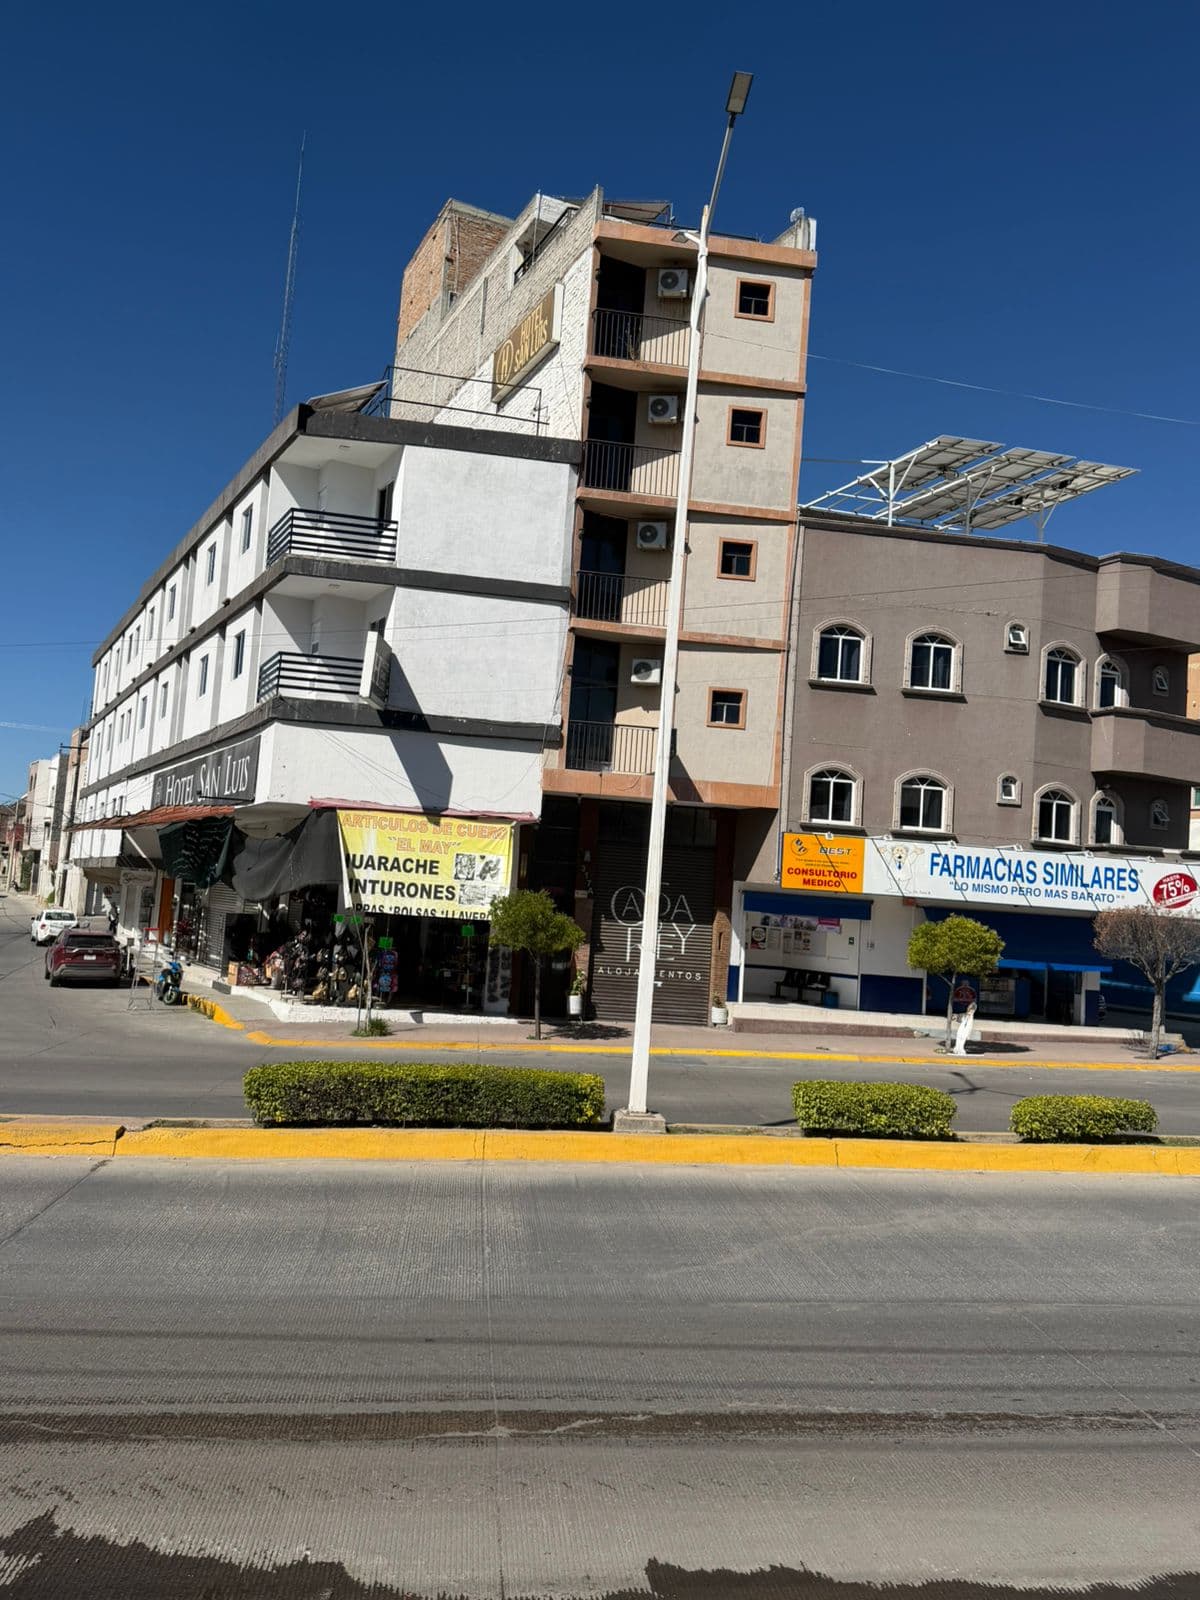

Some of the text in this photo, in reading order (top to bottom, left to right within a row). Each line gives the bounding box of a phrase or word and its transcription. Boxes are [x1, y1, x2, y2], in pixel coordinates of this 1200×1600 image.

[198, 763, 221, 802] SAN
[223, 755, 251, 796] LUIS
[342, 814, 429, 834] ARTICULOS
[787, 867, 858, 880] CONSULTORIO
[929, 852, 1140, 893] FARMACIAS SIMILARES
[348, 878, 456, 901] INTURONES
[802, 878, 841, 889] MEDICO
[971, 883, 1009, 895] MISMO
[1010, 886, 1041, 898] PERO
[1044, 888, 1069, 900] MAS
[1158, 878, 1191, 901] 75%
[597, 967, 702, 981] ALOJAENTOS
